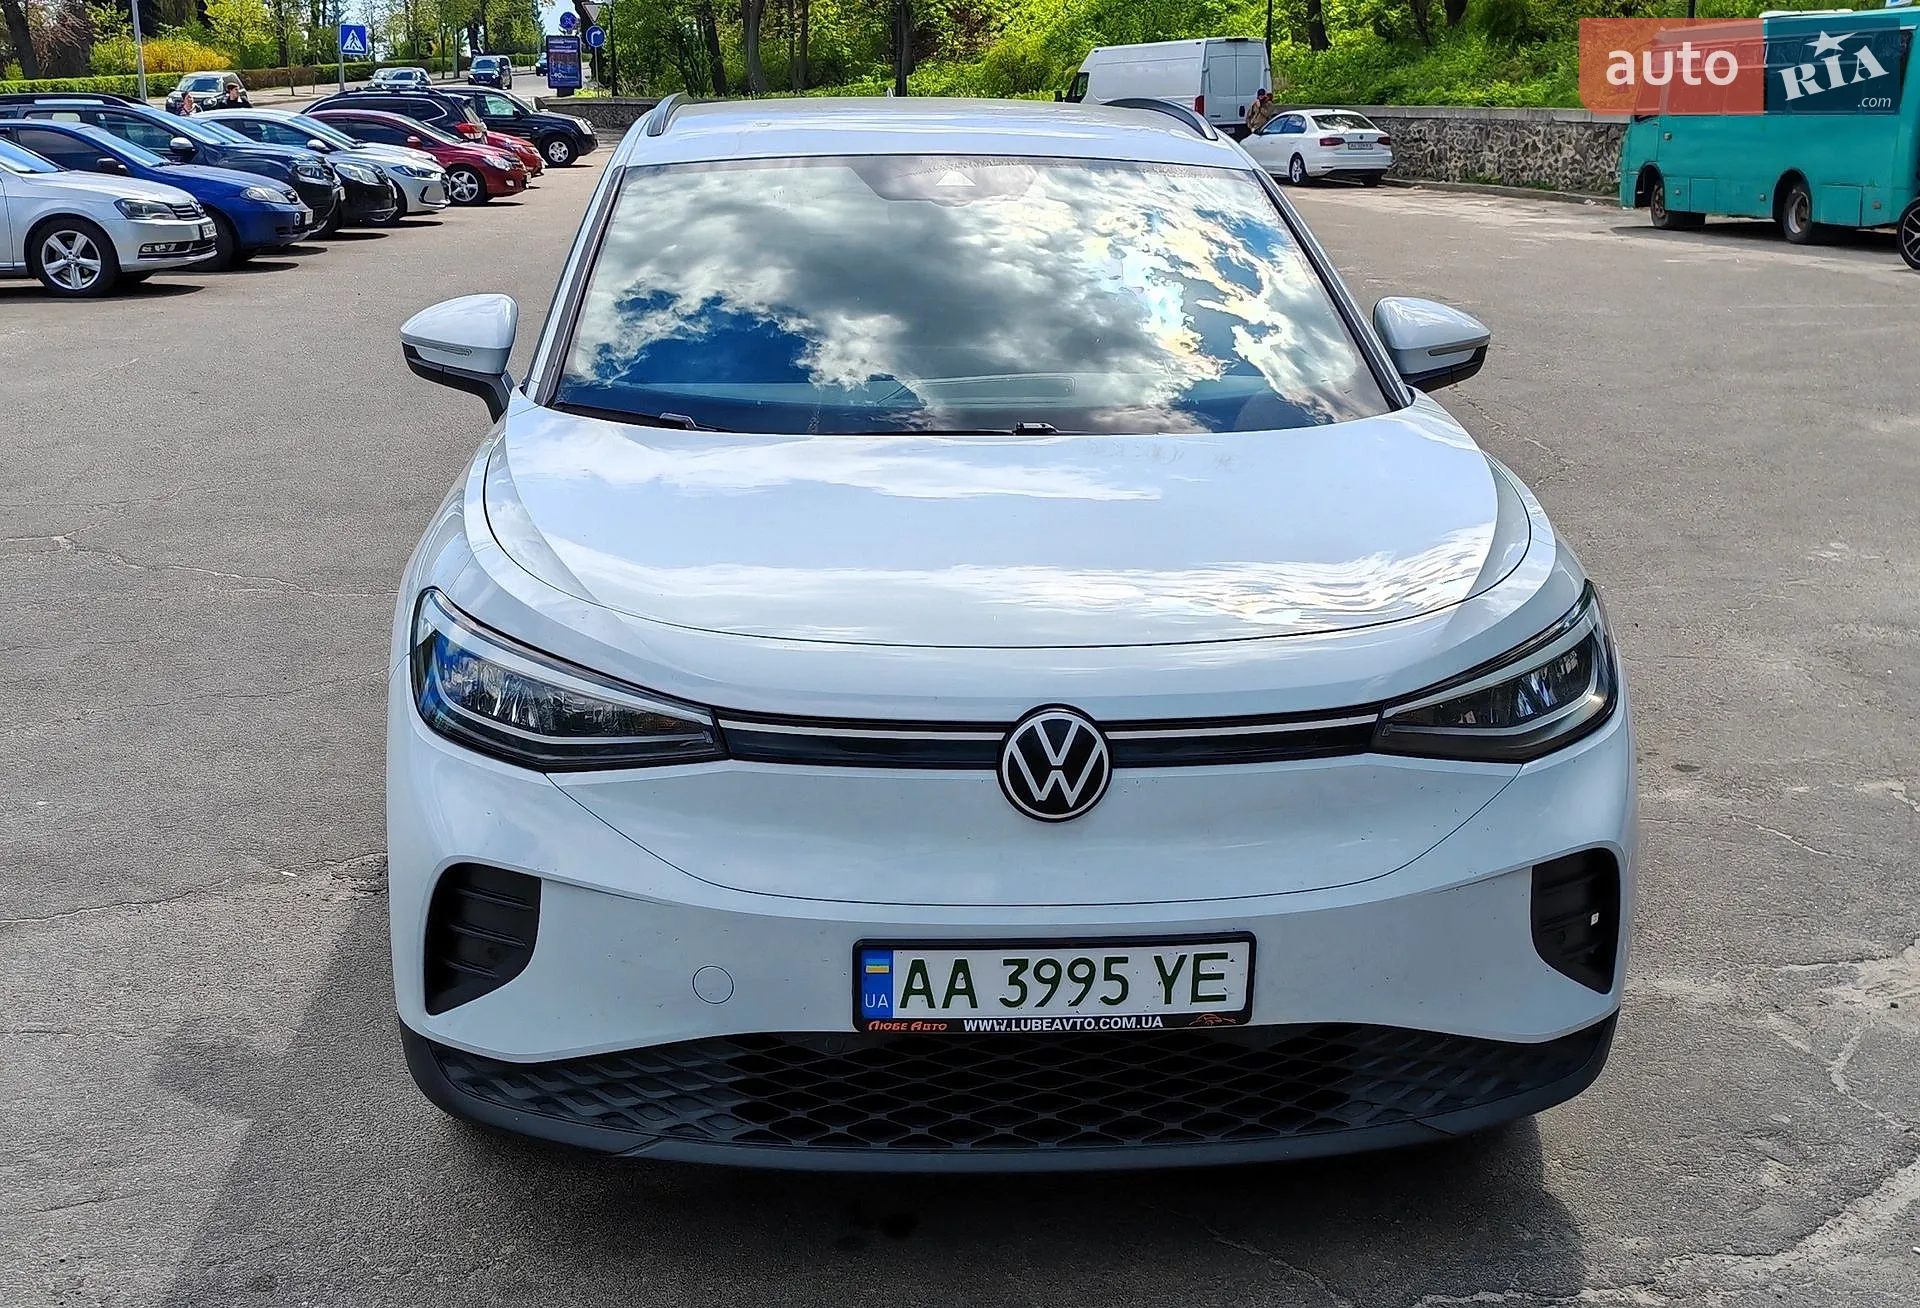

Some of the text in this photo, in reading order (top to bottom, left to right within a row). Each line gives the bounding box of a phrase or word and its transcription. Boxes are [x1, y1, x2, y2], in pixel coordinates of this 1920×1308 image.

[899, 952, 1229, 1008] AA 3995 YE
[865, 994, 889, 1008] UA
[963, 1016, 1163, 1032] WWW.LUBEAVTO.COM.UA
